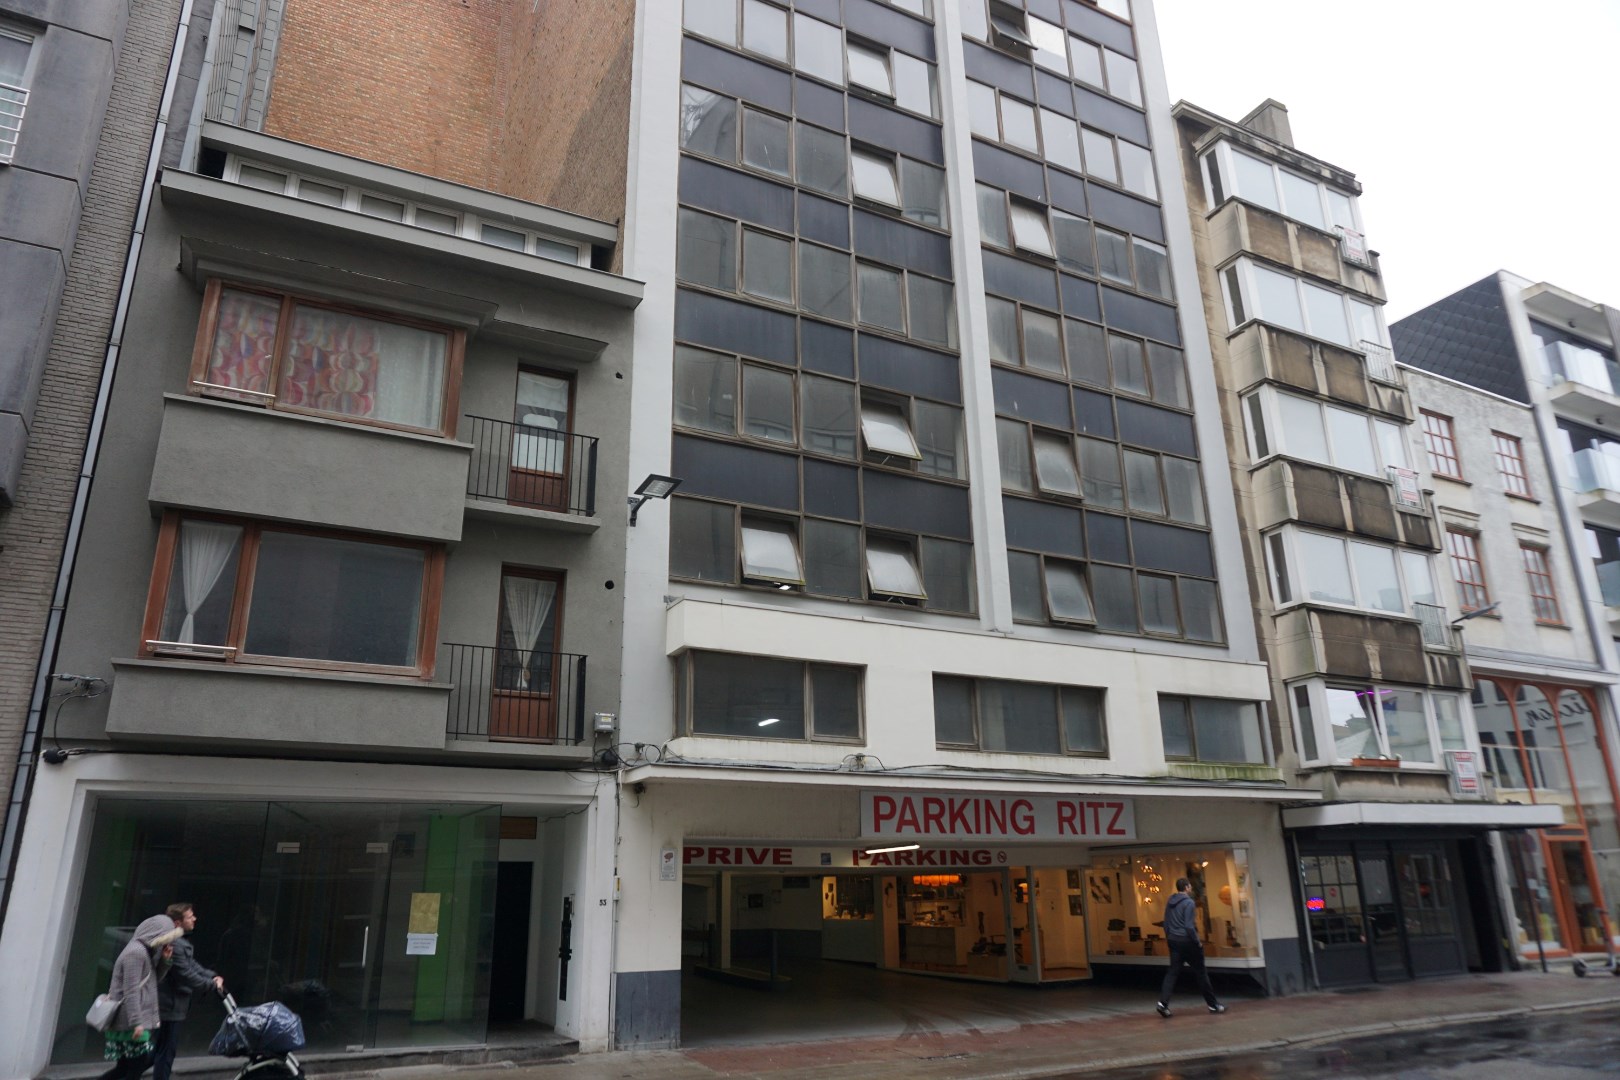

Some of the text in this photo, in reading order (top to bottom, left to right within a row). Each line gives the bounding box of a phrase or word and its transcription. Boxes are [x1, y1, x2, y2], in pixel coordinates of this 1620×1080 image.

[873, 795, 1126, 836] PARKING RITZ
[683, 847, 992, 867] PRIVE PARKING
[599, 898, 607, 907] 53
